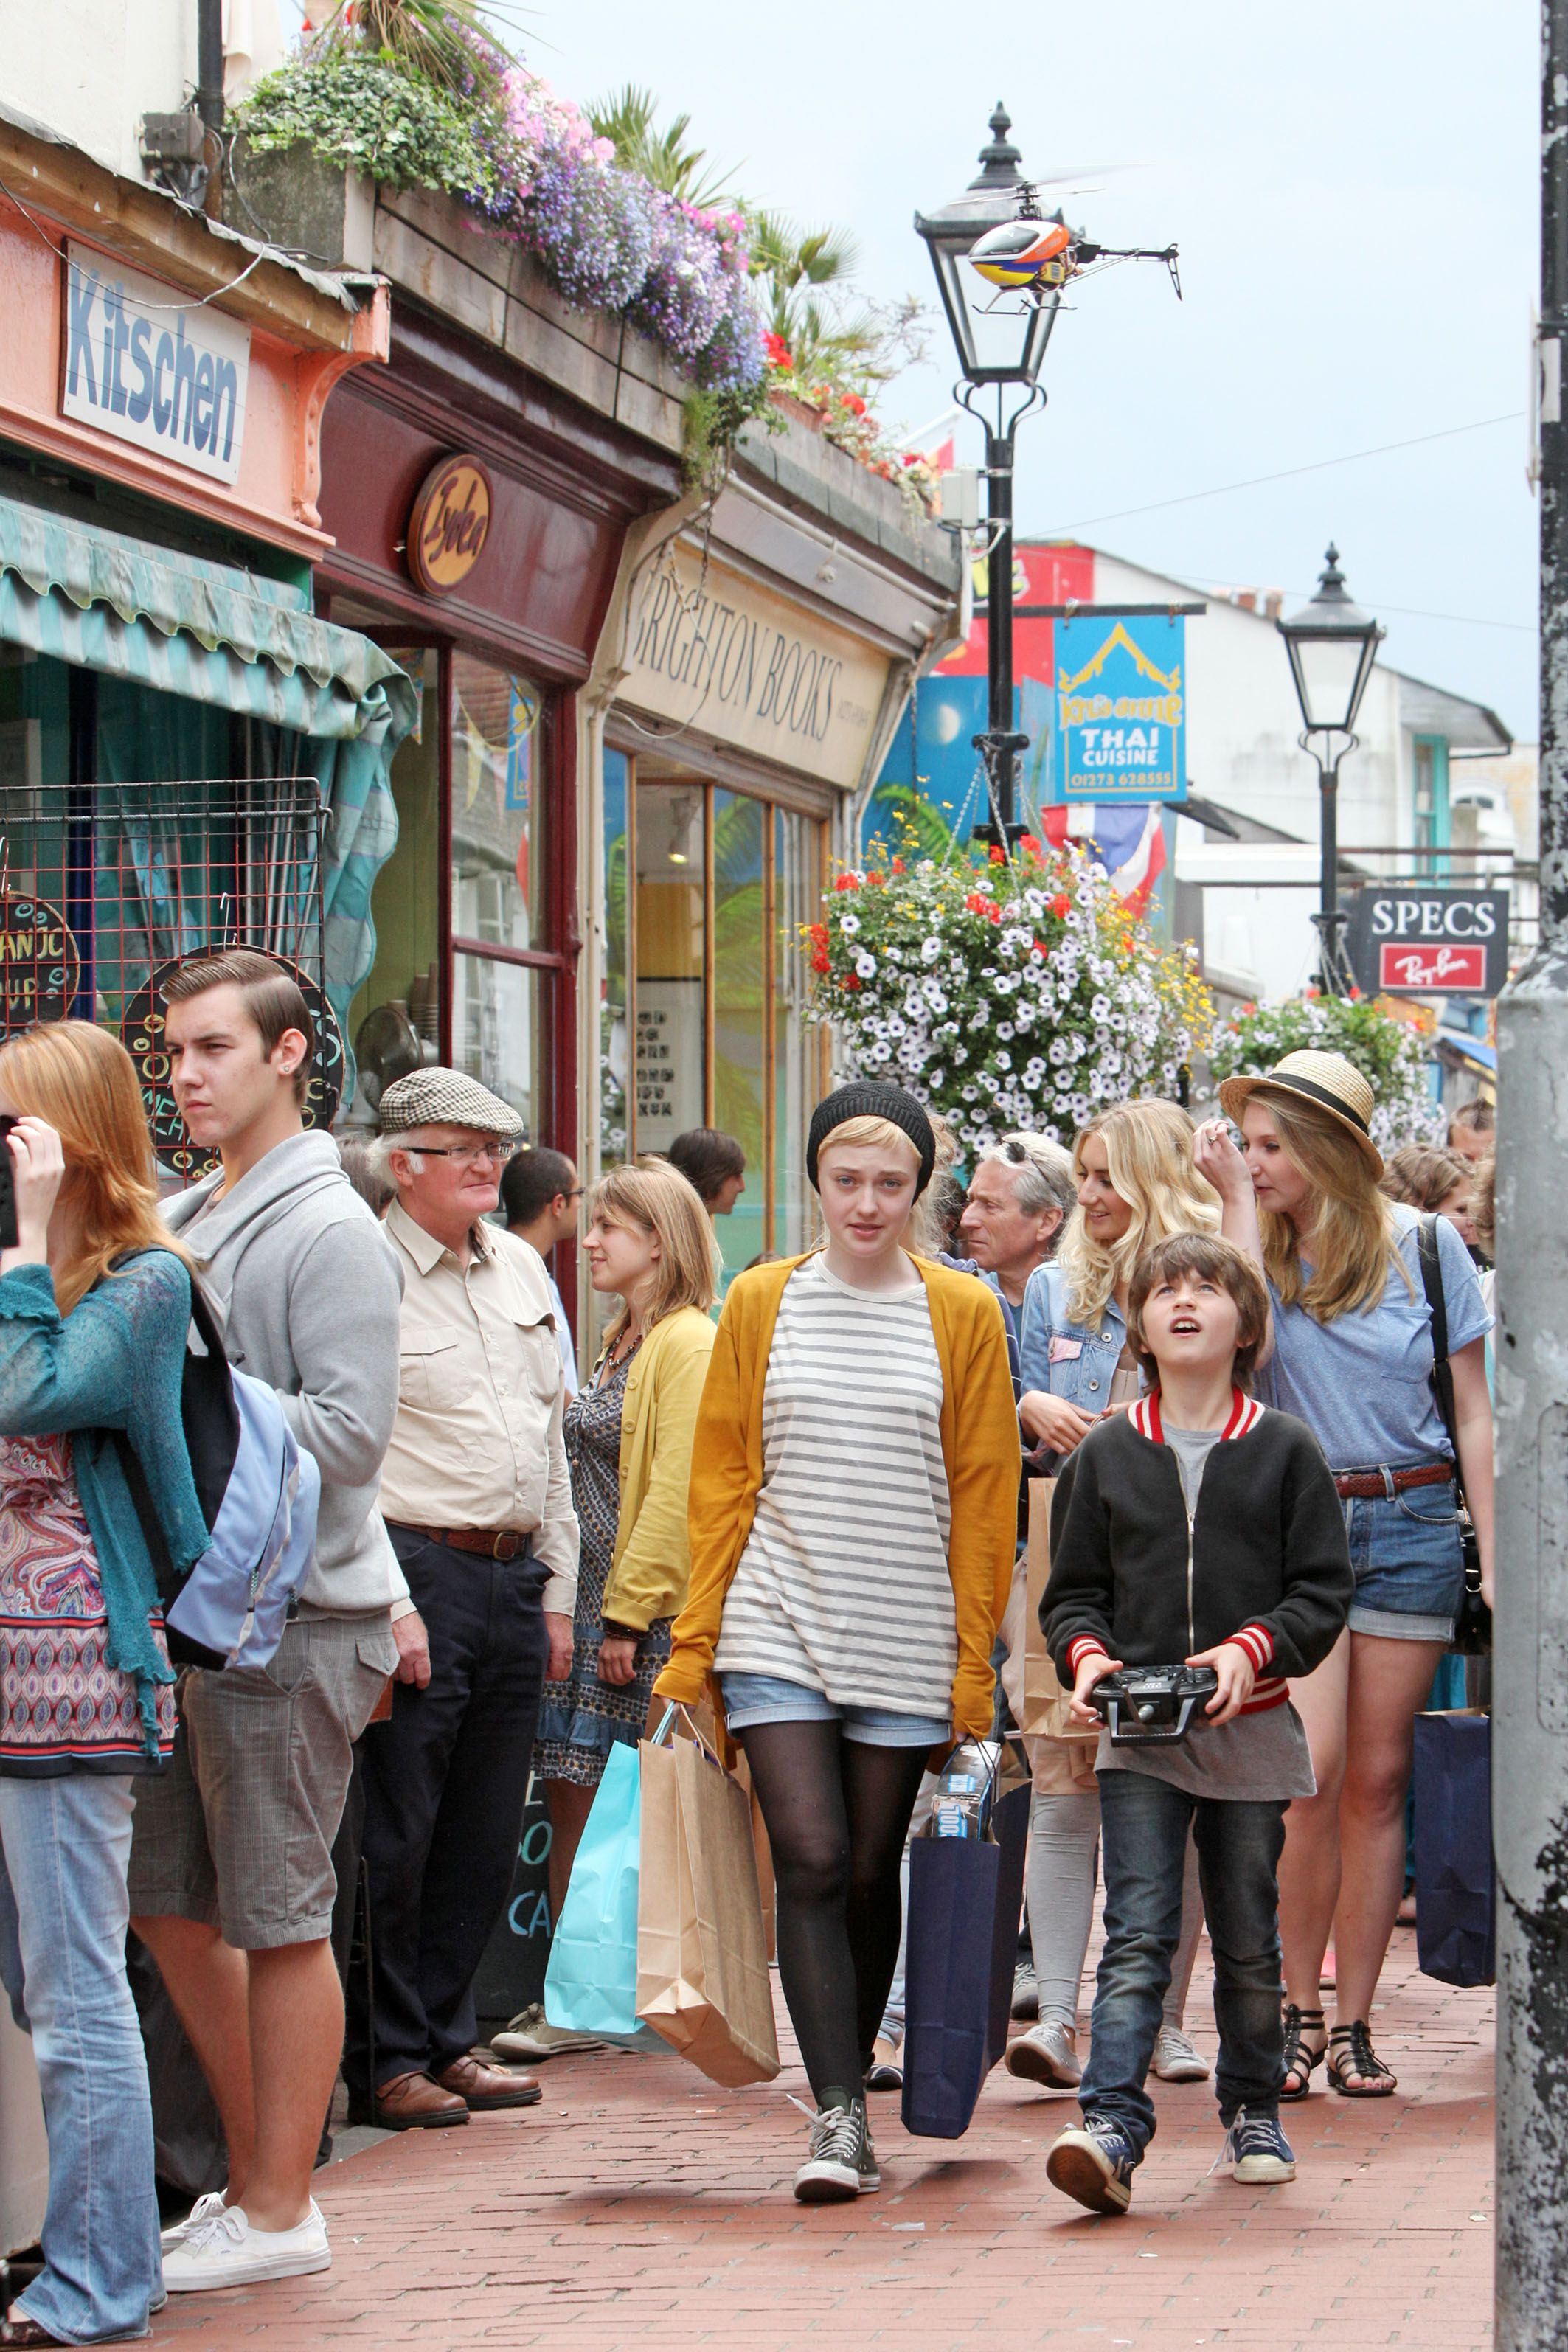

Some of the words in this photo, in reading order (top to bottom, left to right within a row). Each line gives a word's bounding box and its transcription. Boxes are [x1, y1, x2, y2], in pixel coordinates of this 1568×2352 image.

[67, 260, 237, 462] Kitschen
[757, 633, 842, 742] BOOKS
[1080, 727, 1159, 749] THAI
[1082, 749, 1159, 767] CUISINE
[1071, 774, 1114, 787] 01273
[1372, 900, 1496, 937] SPECS
